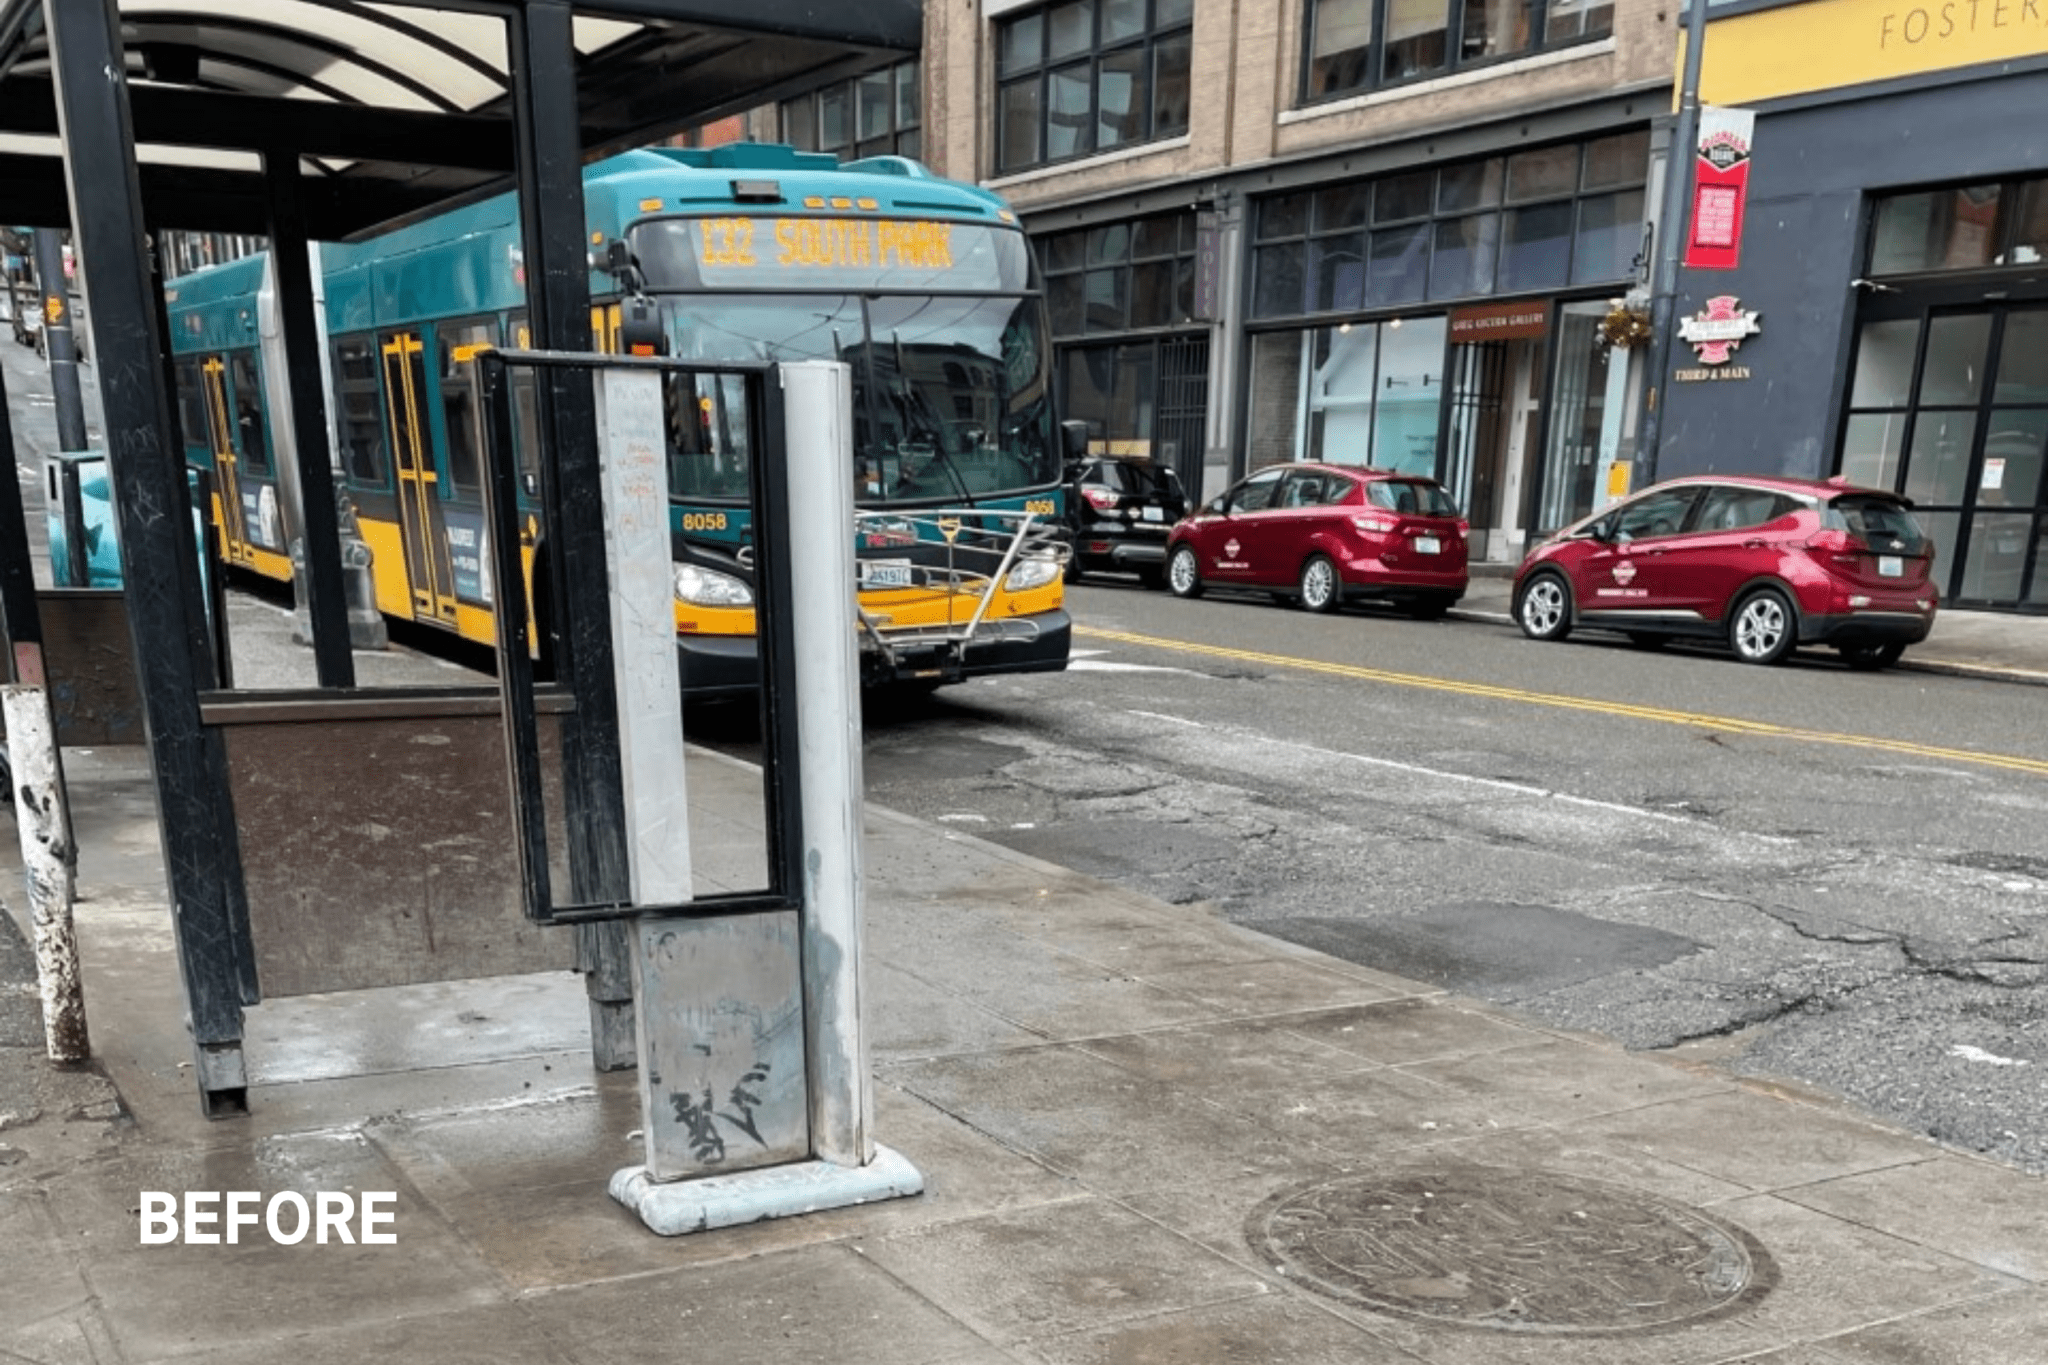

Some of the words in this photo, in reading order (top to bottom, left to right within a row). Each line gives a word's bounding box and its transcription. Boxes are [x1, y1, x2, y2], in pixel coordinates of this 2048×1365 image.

[700, 217, 756, 267] 132
[775, 217, 871, 267] SOUTH
[877, 219, 953, 268] PARK
[1720, 366, 1750, 379] MAIN
[683, 513, 727, 530] 8058
